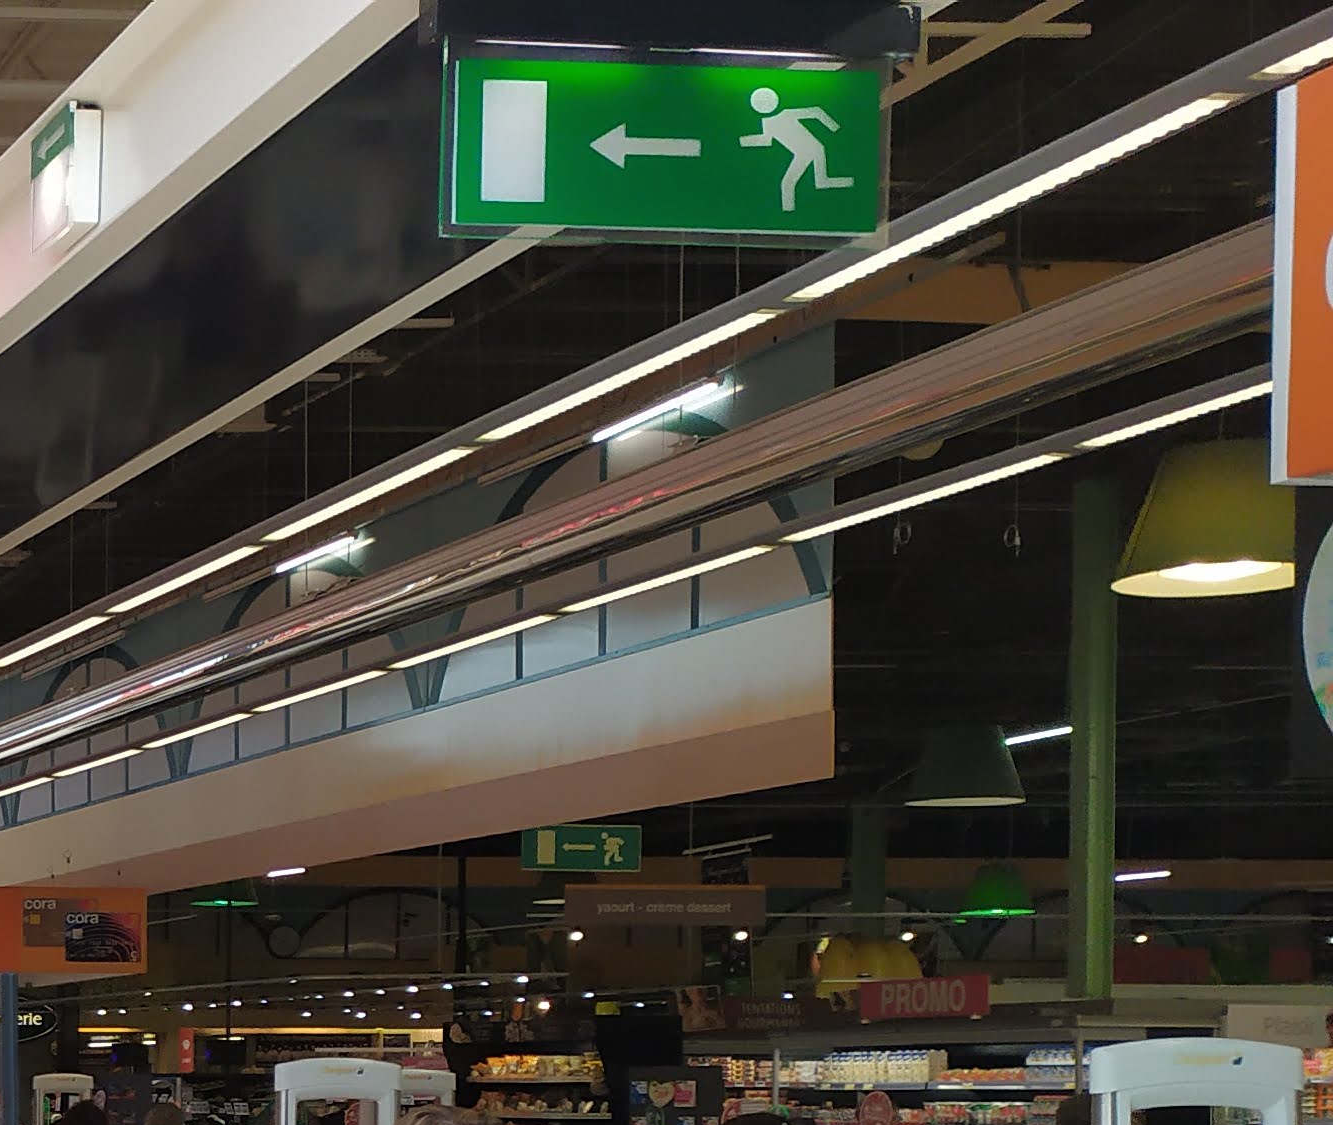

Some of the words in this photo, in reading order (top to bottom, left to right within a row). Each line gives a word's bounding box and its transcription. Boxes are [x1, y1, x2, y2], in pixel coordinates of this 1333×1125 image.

[23, 899, 57, 910] cora
[596, 902, 635, 915] yaourt
[687, 901, 732, 914] dessert
[66, 913, 100, 925] cora
[880, 979, 967, 1017] PROMO
